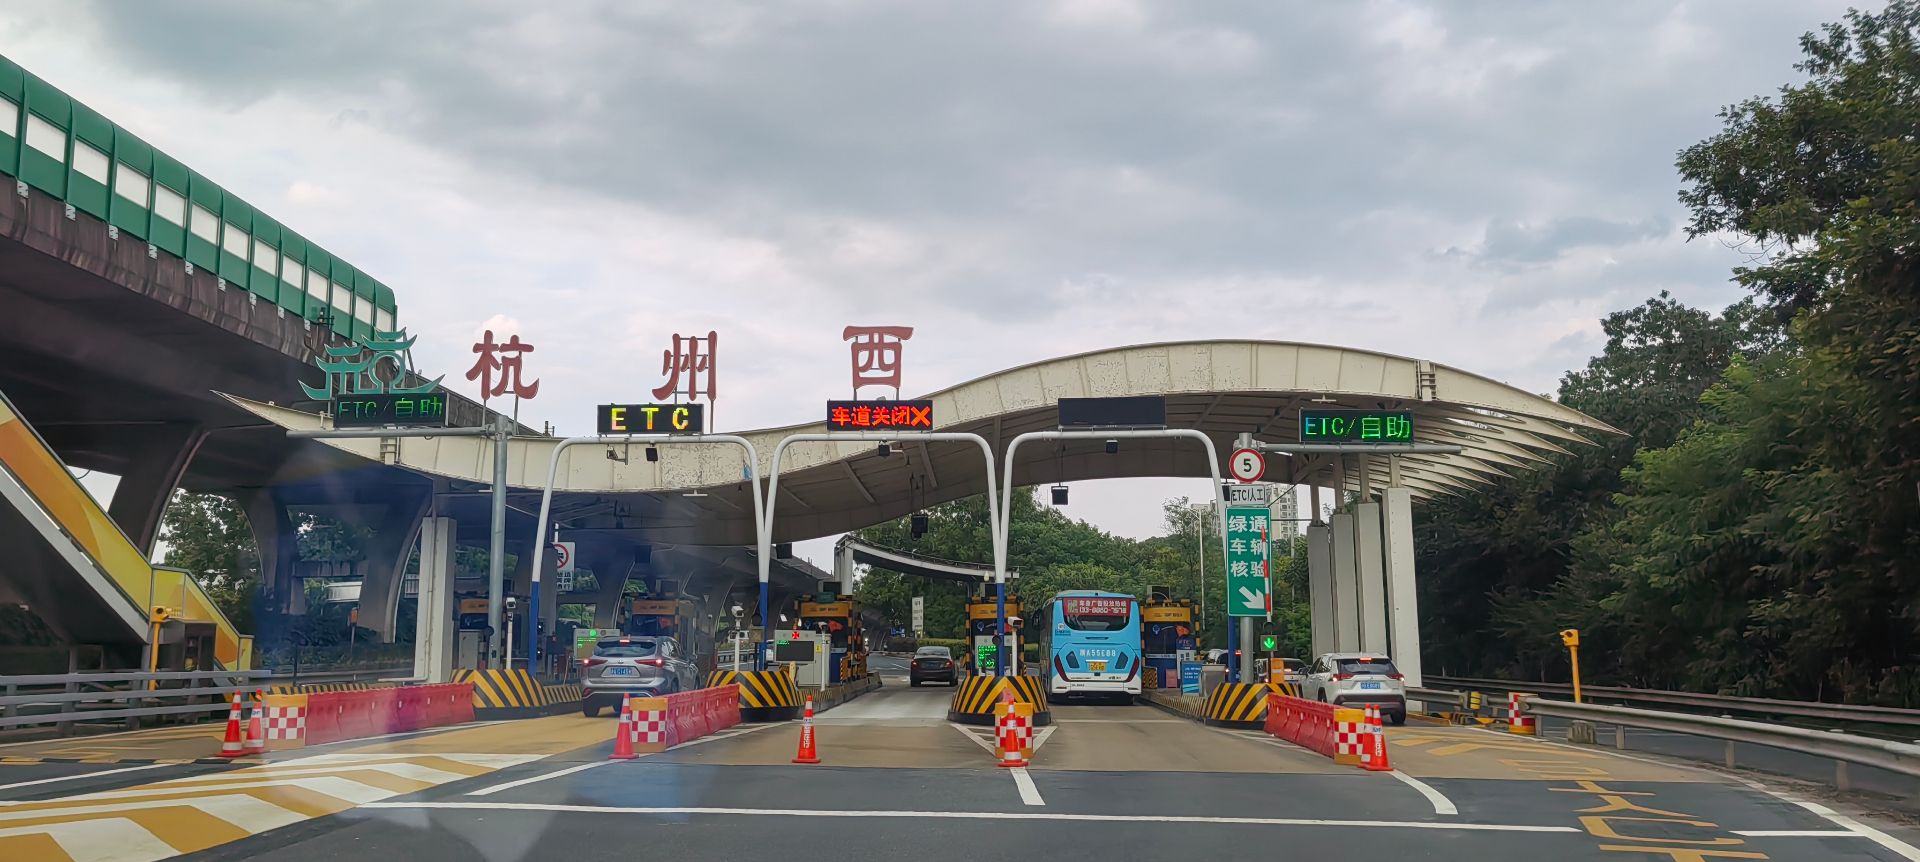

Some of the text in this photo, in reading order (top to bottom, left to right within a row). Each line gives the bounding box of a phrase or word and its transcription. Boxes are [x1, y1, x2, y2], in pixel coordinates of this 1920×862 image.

[831, 405, 911, 427] 车道关闭
[1305, 414, 1411, 439] ETC/自助
[1243, 458, 1252, 473] 5
[1228, 515, 1268, 533] 绿通
